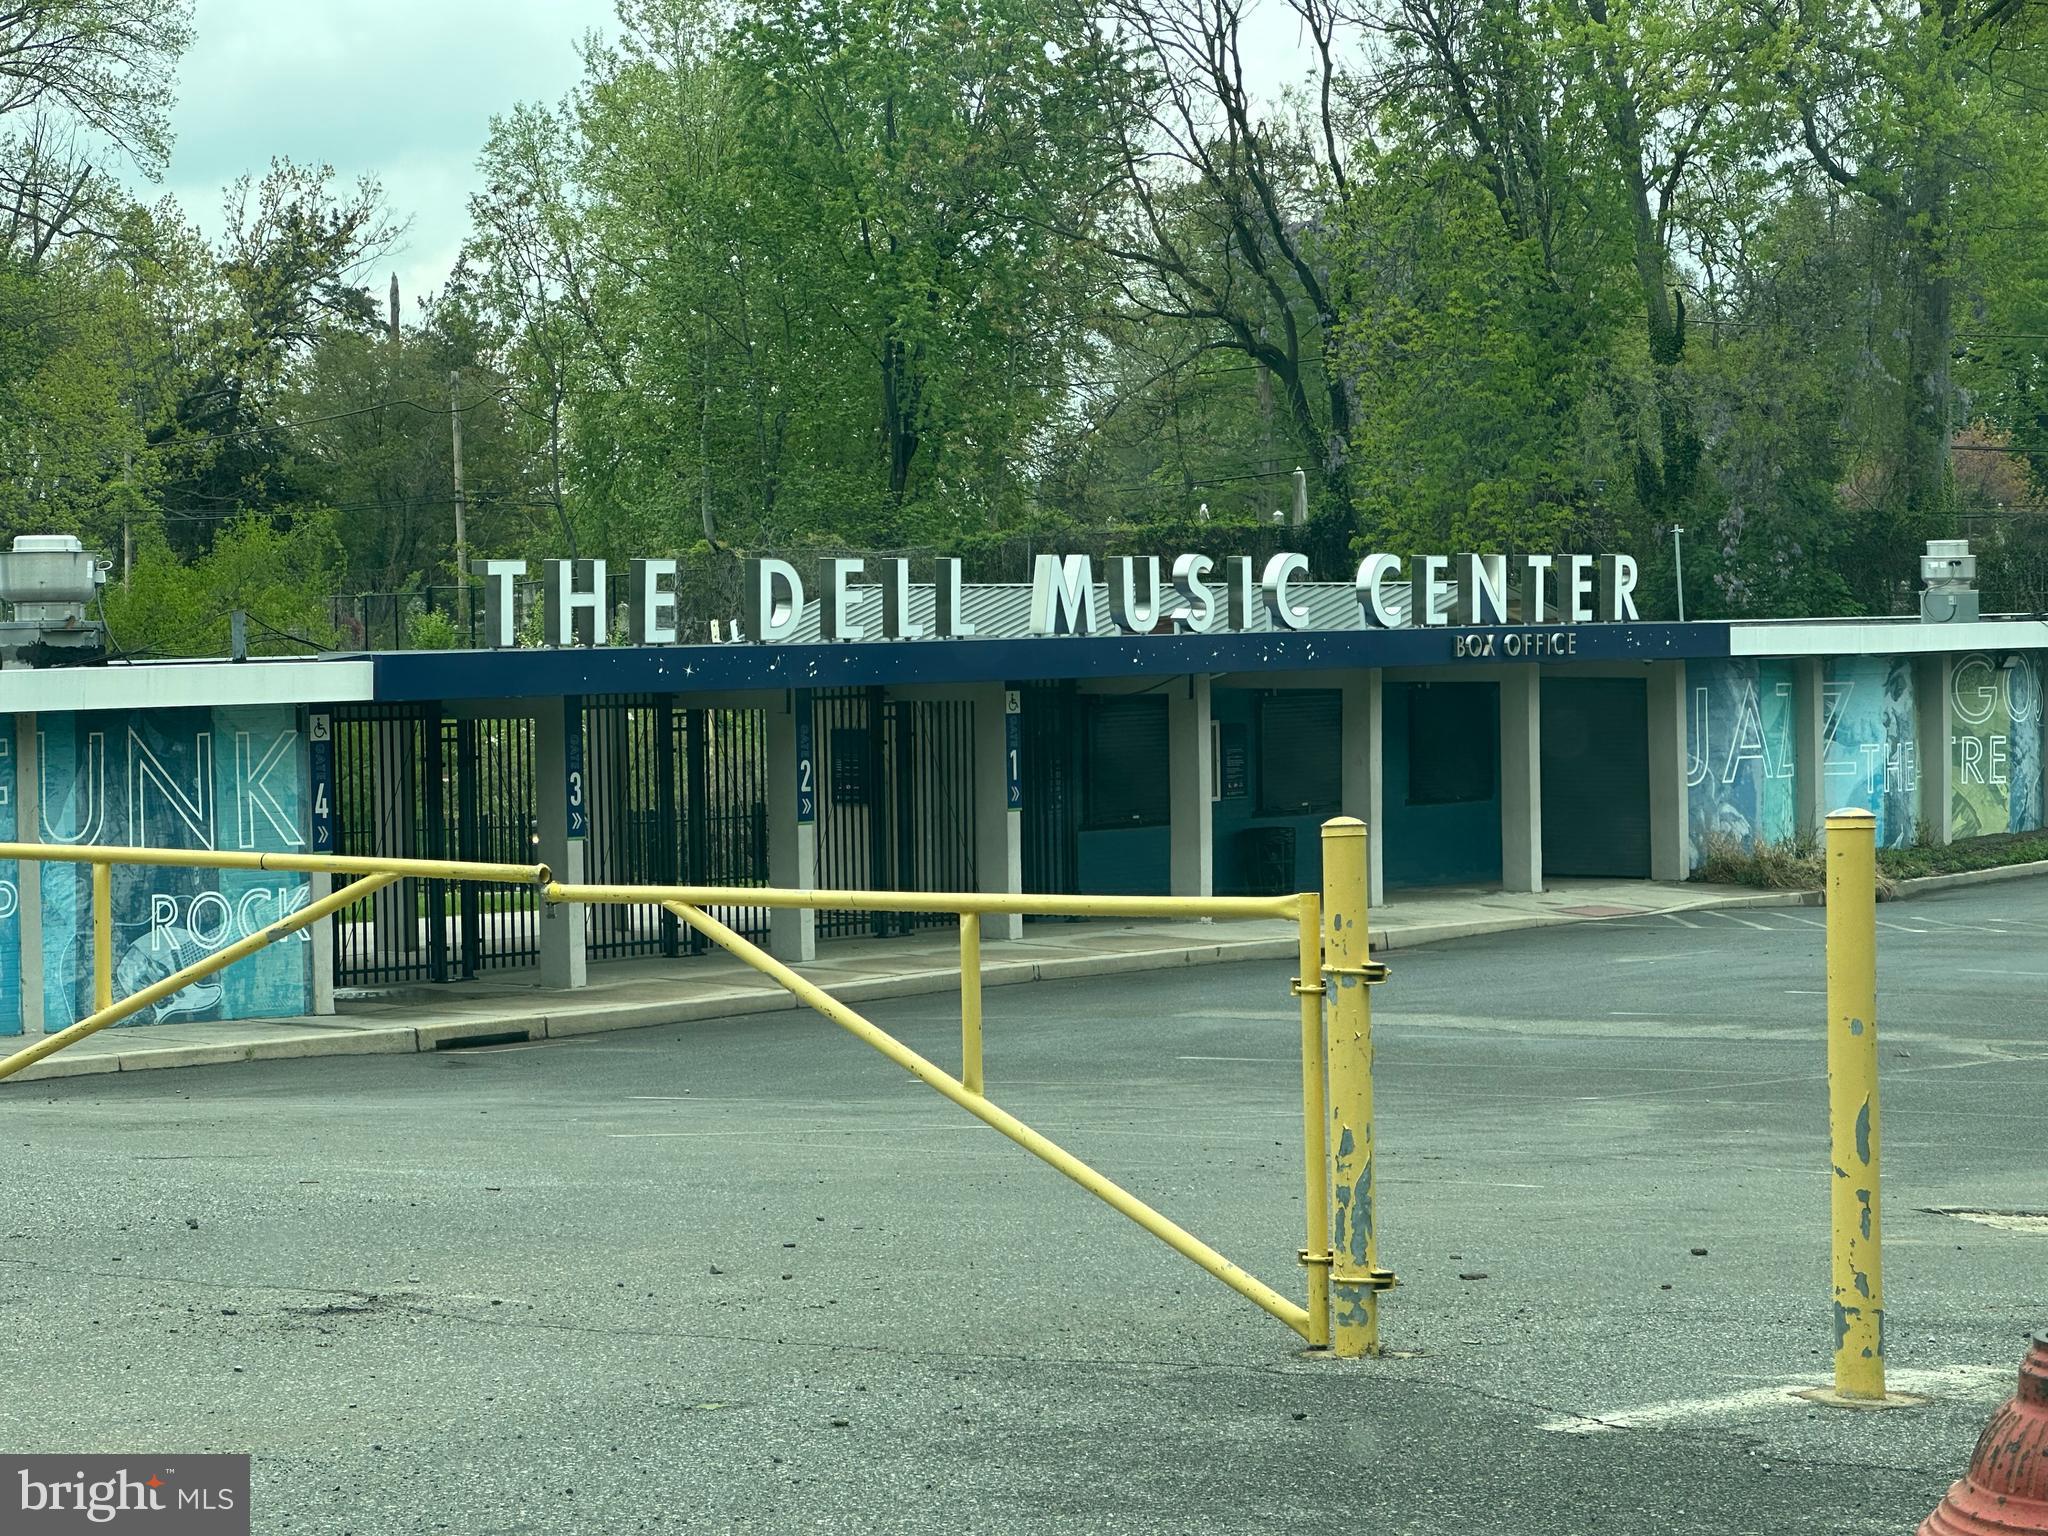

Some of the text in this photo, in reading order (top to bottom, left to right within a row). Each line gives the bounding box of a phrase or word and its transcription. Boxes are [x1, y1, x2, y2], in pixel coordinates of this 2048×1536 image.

[474, 552, 1640, 645] THE DELL MUSIC CENTER
[1456, 633, 1577, 657] BOX OFFICE
[800, 760, 812, 792] 2
[1009, 750, 1018, 780] 1
[314, 783, 329, 819] 4
[569, 771, 582, 806] 3
[151, 885, 311, 951] ROCK
